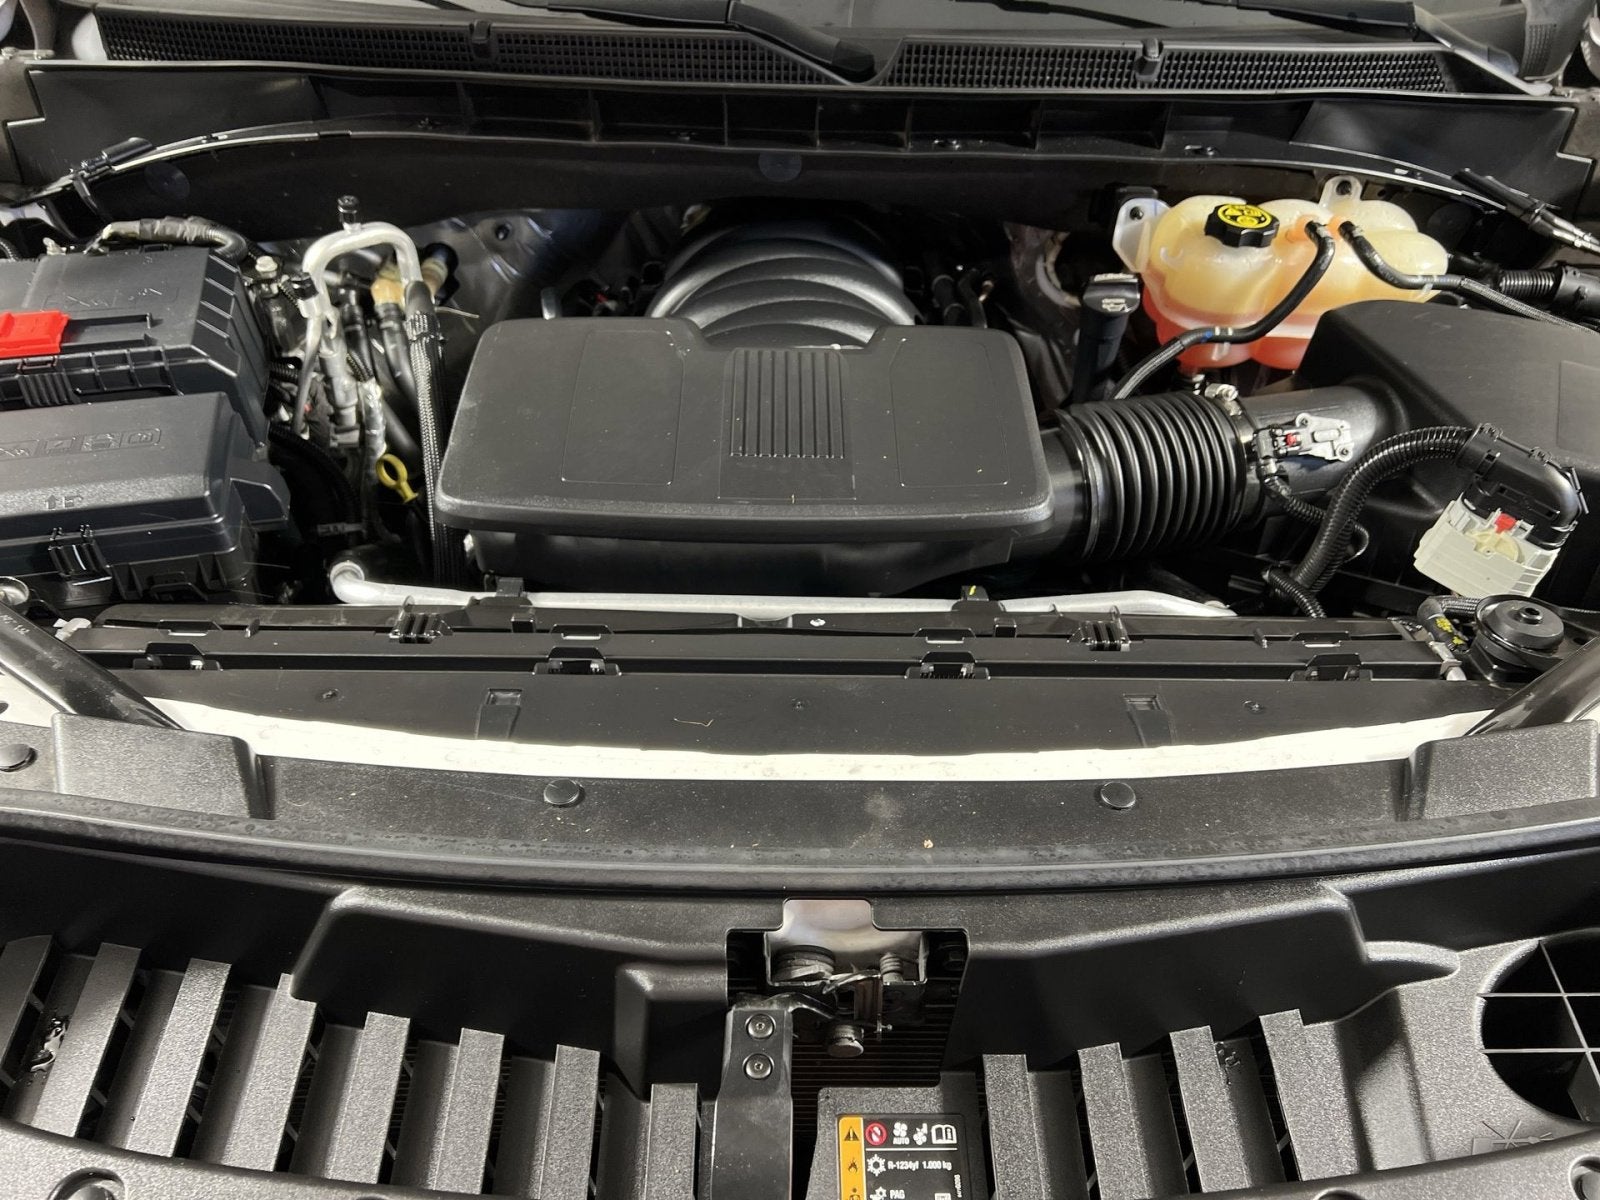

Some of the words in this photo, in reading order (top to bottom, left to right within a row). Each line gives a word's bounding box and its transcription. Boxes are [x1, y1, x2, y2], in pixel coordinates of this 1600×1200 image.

[893, 1137, 910, 1145] AUTO
[887, 1160, 919, 1171] R-1234yf
[922, 1160, 942, 1169] 1.000
[942, 1160, 952, 1171] kg
[889, 1189, 905, 1199] PAG
